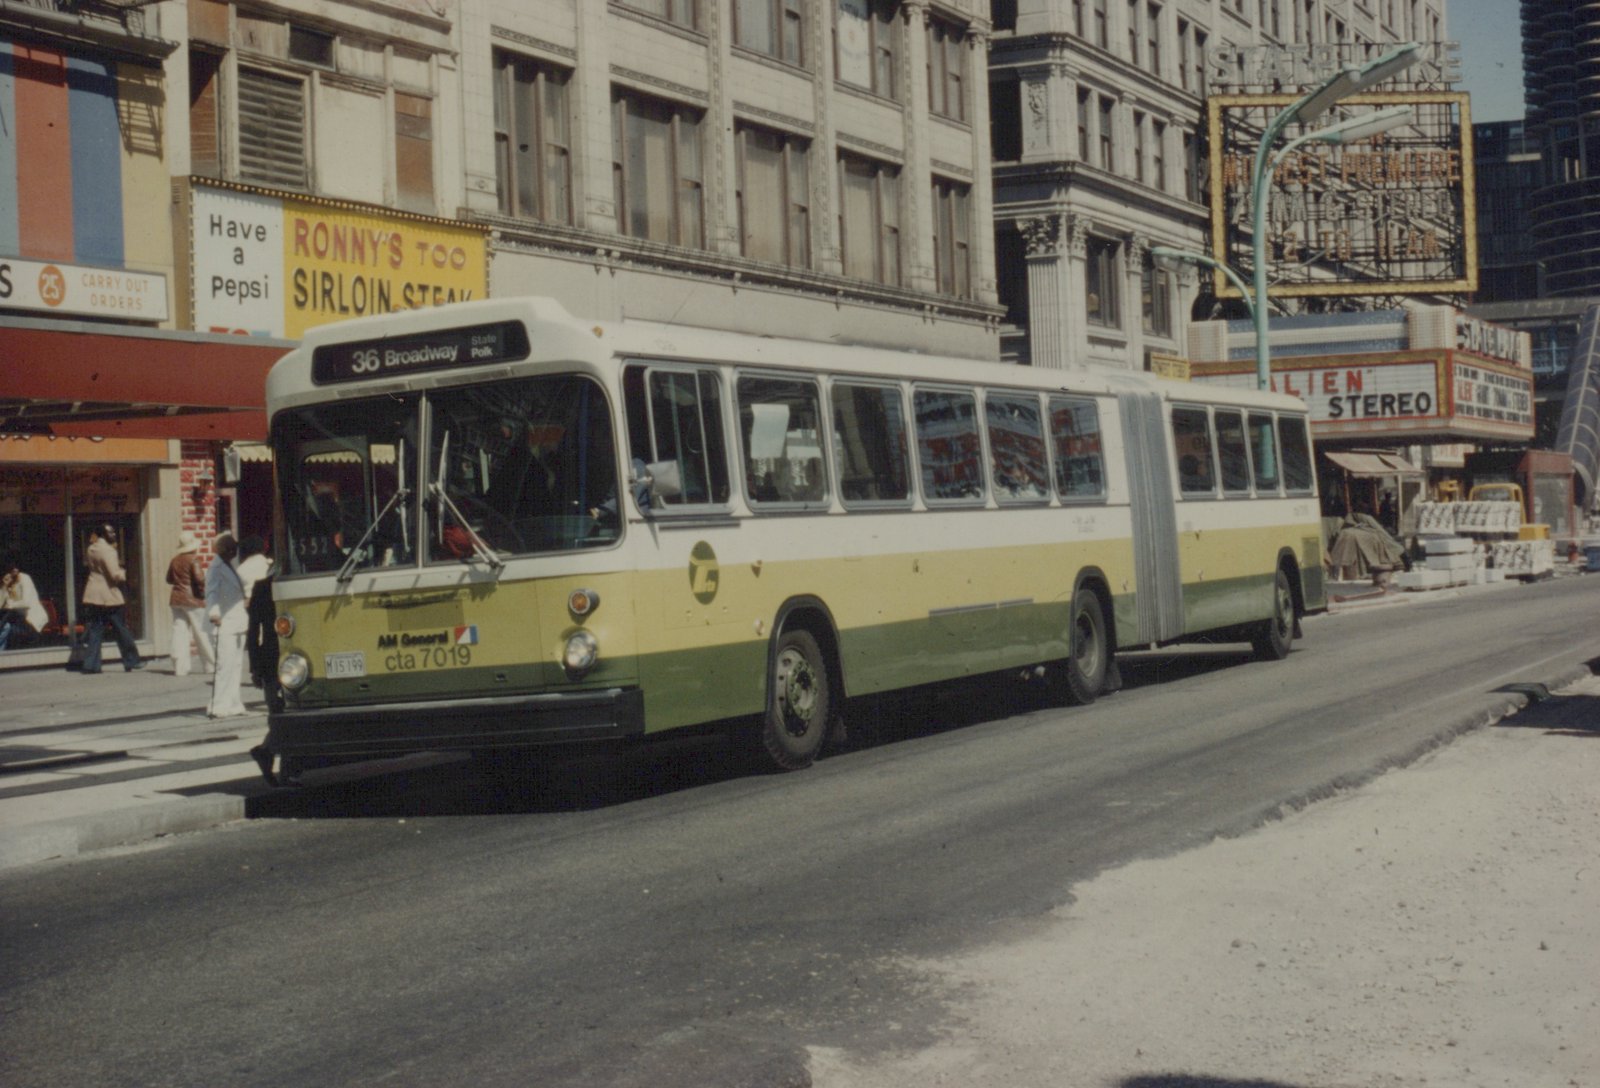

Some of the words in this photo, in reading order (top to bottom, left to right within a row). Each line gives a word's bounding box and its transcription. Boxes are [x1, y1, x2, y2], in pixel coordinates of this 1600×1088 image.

[1342, 151, 1461, 183] PREMIERE
[210, 214, 267, 242] Have
[233, 247, 244, 265] a
[294, 218, 403, 270] RONNY'S
[416, 241, 467, 271] TOO
[82, 273, 121, 290] CARRY
[126, 279, 149, 293] OUT
[293, 268, 392, 315] SIRLOIN
[90, 294, 143, 310] ORDERS
[352, 348, 380, 373] 36
[385, 343, 458, 367] Broadway
[471, 334, 497, 346] State
[471, 347, 493, 359] Polk
[1329, 391, 1431, 418] STEREO
[378, 634, 397, 648] AM
[401, 630, 448, 647] General
[385, 651, 416, 671] cta
[420, 645, 471, 668] 7019
